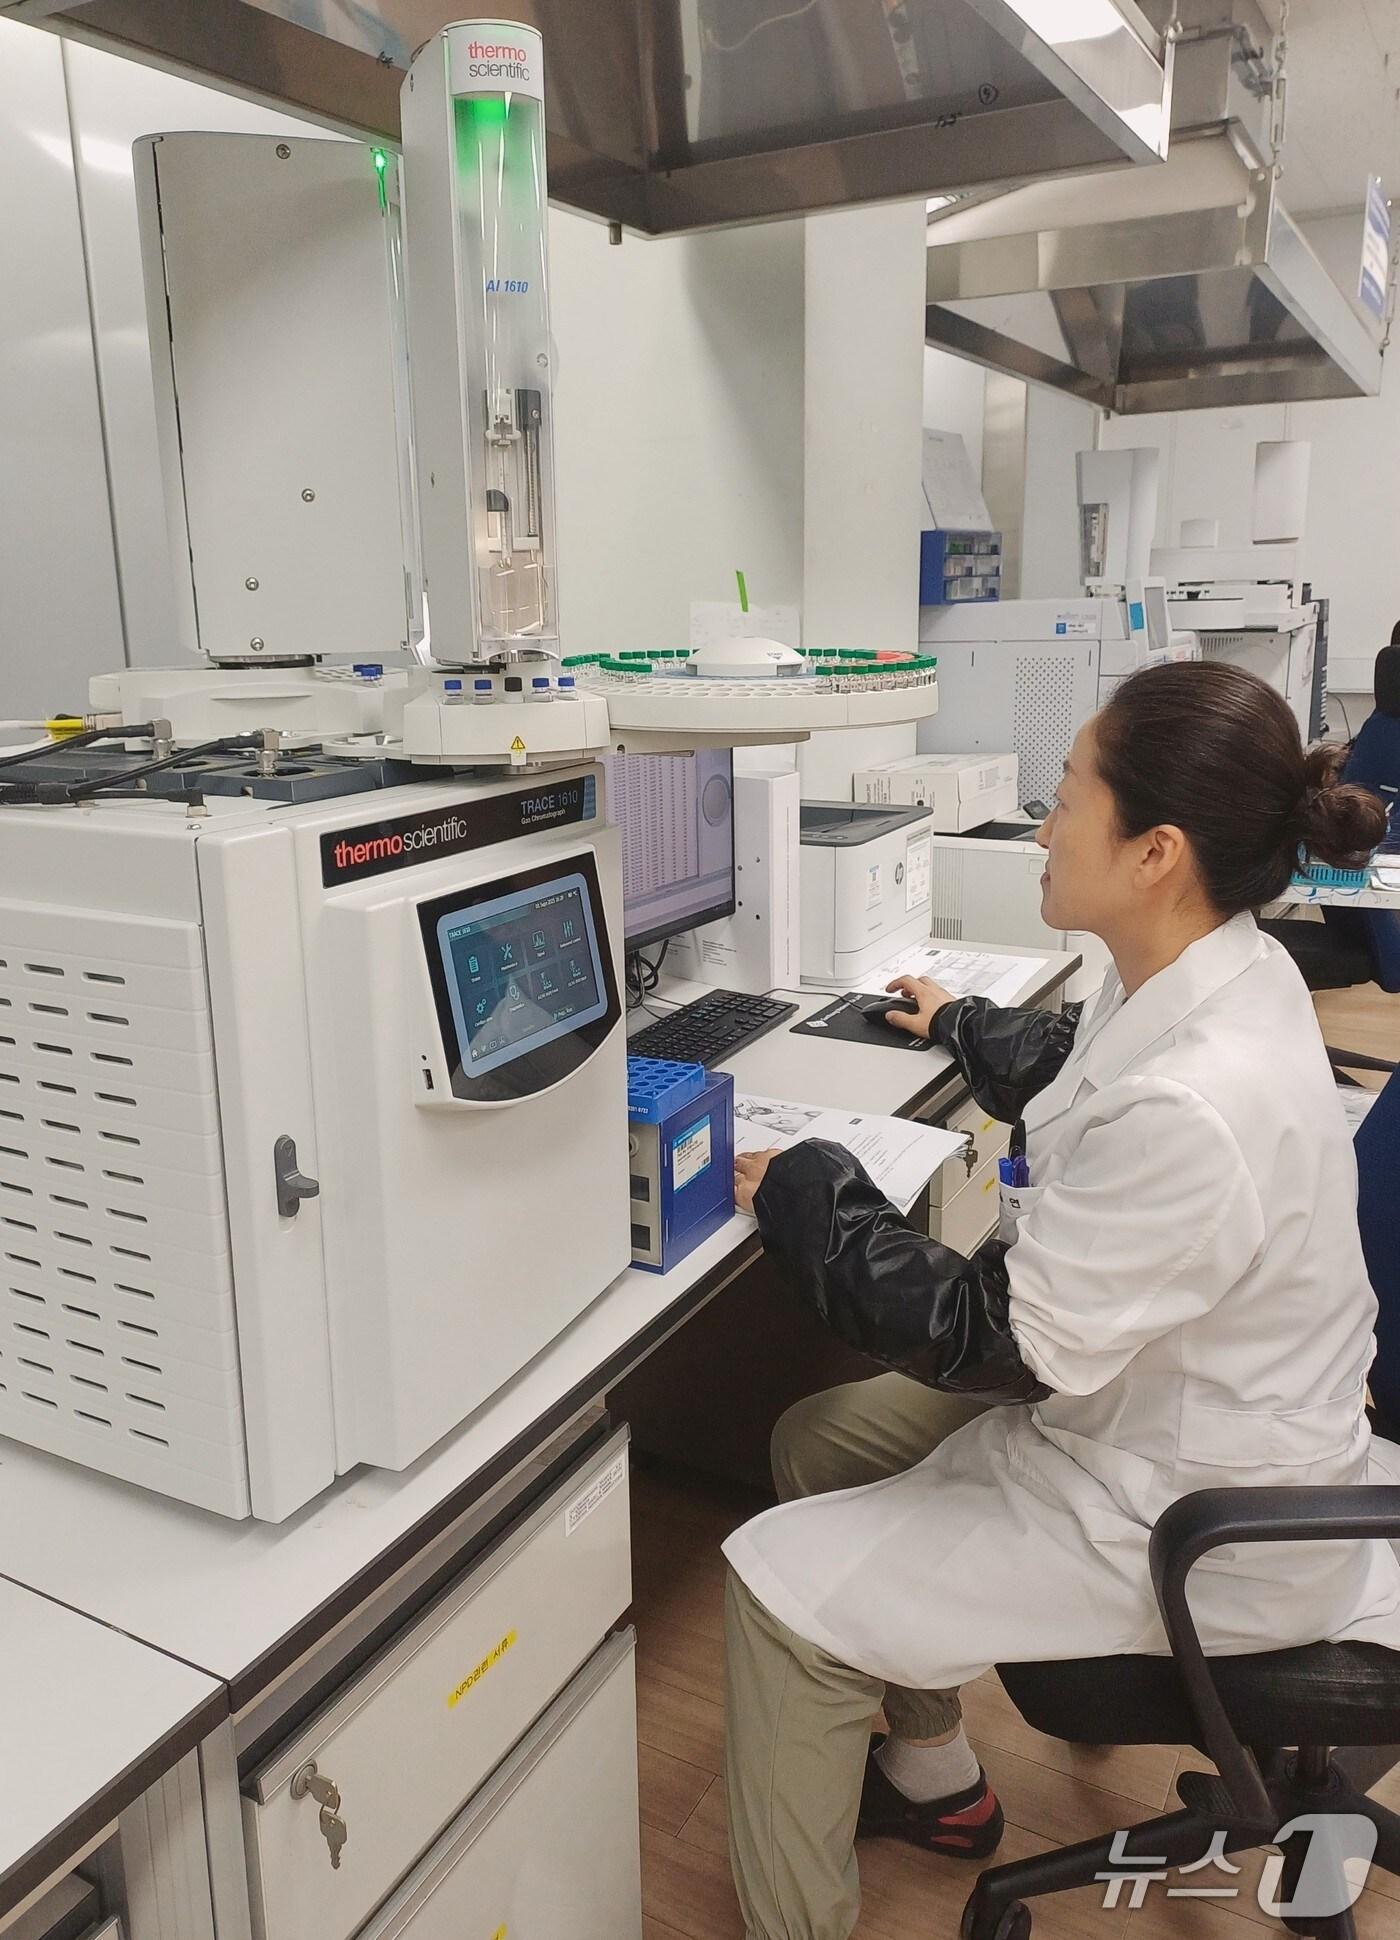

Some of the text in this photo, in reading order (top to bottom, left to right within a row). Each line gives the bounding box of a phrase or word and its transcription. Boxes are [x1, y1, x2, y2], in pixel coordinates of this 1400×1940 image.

[468, 41, 526, 62] thermo
[469, 60, 530, 81] scientific
[486, 280, 529, 293] AI 1610
[520, 790, 578, 815] TRACE 1610
[521, 808, 566, 825] Gas Chromatograph
